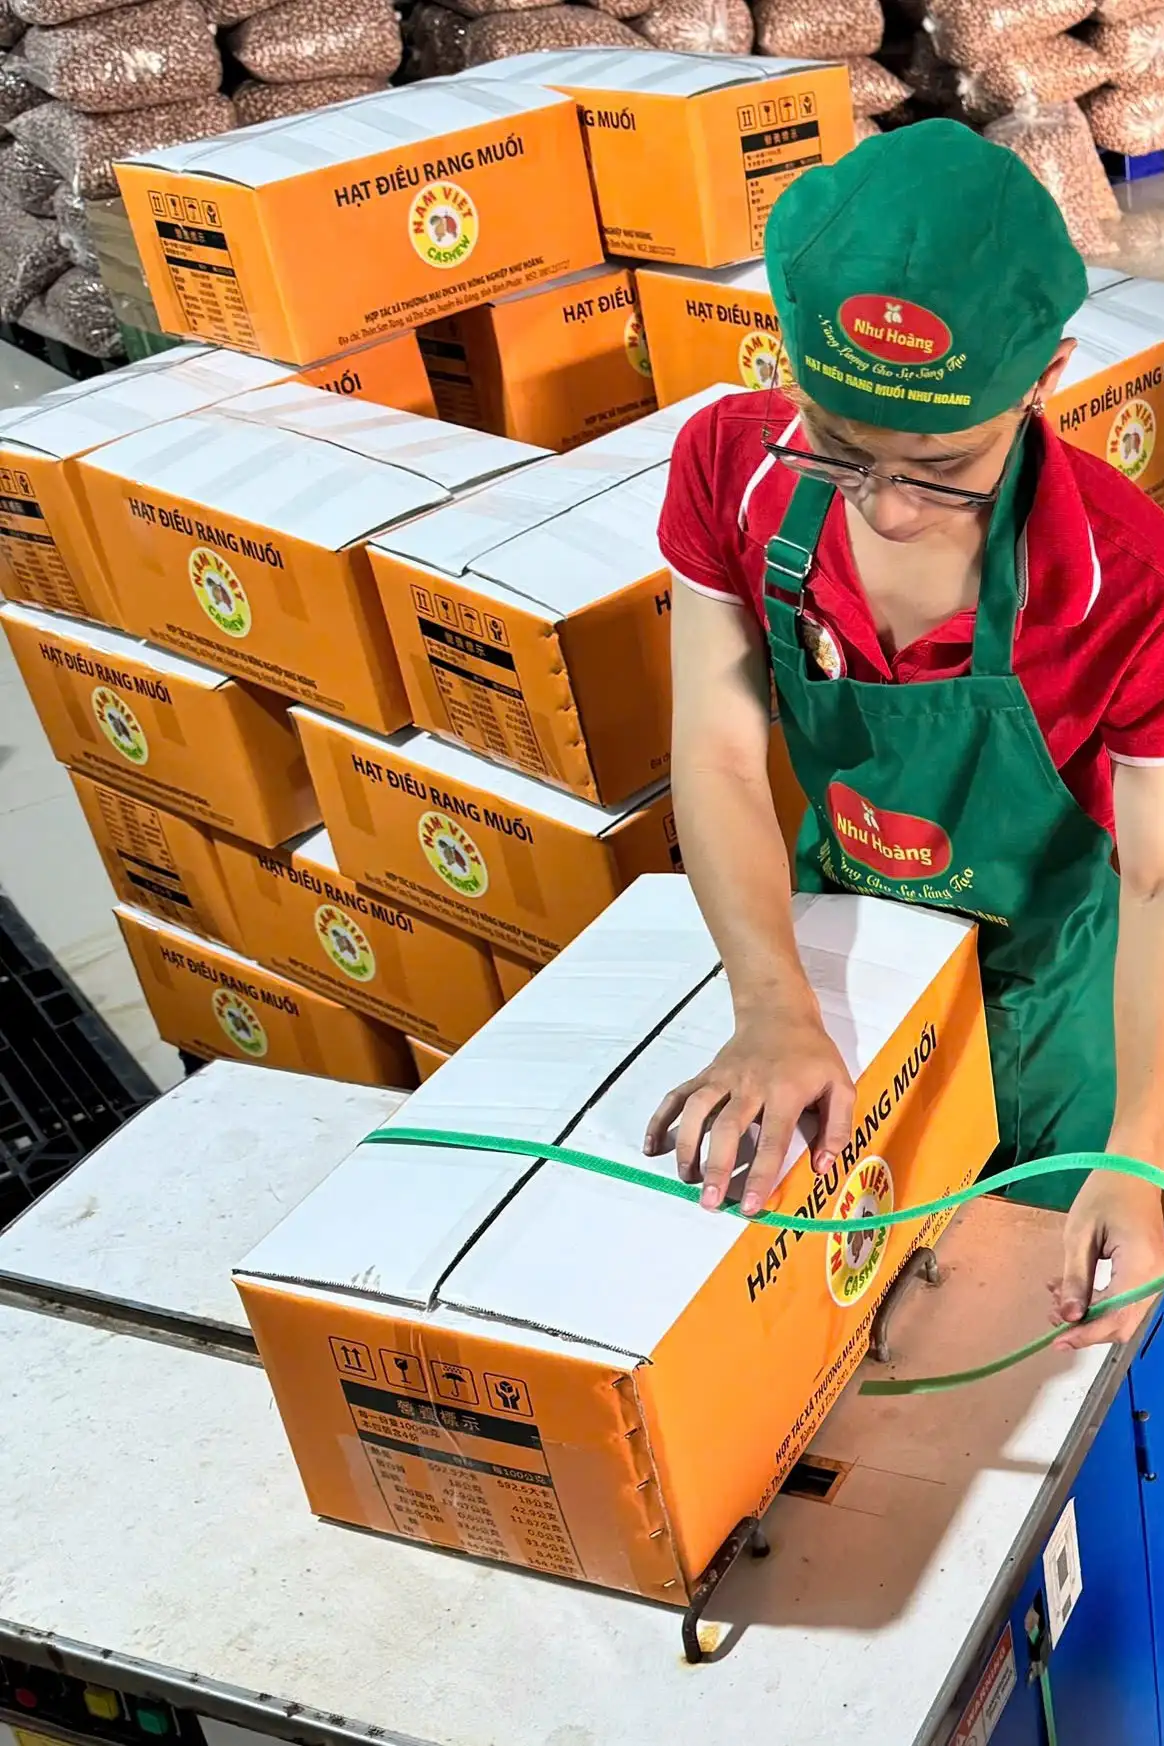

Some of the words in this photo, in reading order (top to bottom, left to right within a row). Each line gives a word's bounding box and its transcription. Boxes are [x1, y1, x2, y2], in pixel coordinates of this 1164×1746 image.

[334, 181, 370, 207] HẠT
[424, 153, 474, 182] RANG
[477, 133, 524, 166] MUỐI
[414, 190, 436, 234] NAM
[427, 235, 470, 263] CASHEW
[563, 299, 594, 323] HẠT
[686, 300, 713, 322] HẠT
[854, 318, 884, 338] Như
[887, 328, 934, 353] Hoàng
[872, 363, 893, 378] Cho
[1060, 403, 1087, 432] HẠT
[1125, 367, 1162, 403] RANG
[196, 520, 239, 553] RANG
[96, 663, 132, 691] RANG
[352, 754, 383, 783] HẠT
[430, 787, 481, 822] RANG
[483, 808, 534, 844] MUỐI
[872, 834, 931, 866] Hoàng
[323, 880, 368, 913] RANG
[866, 874, 891, 894] Cho
[220, 972, 258, 1000] RANG
[746, 1234, 790, 1302] HẠT
[842, 1089, 892, 1175] RANG
[895, 1021, 937, 1103] MUỐI
[844, 1225, 886, 1298] CASHEW
